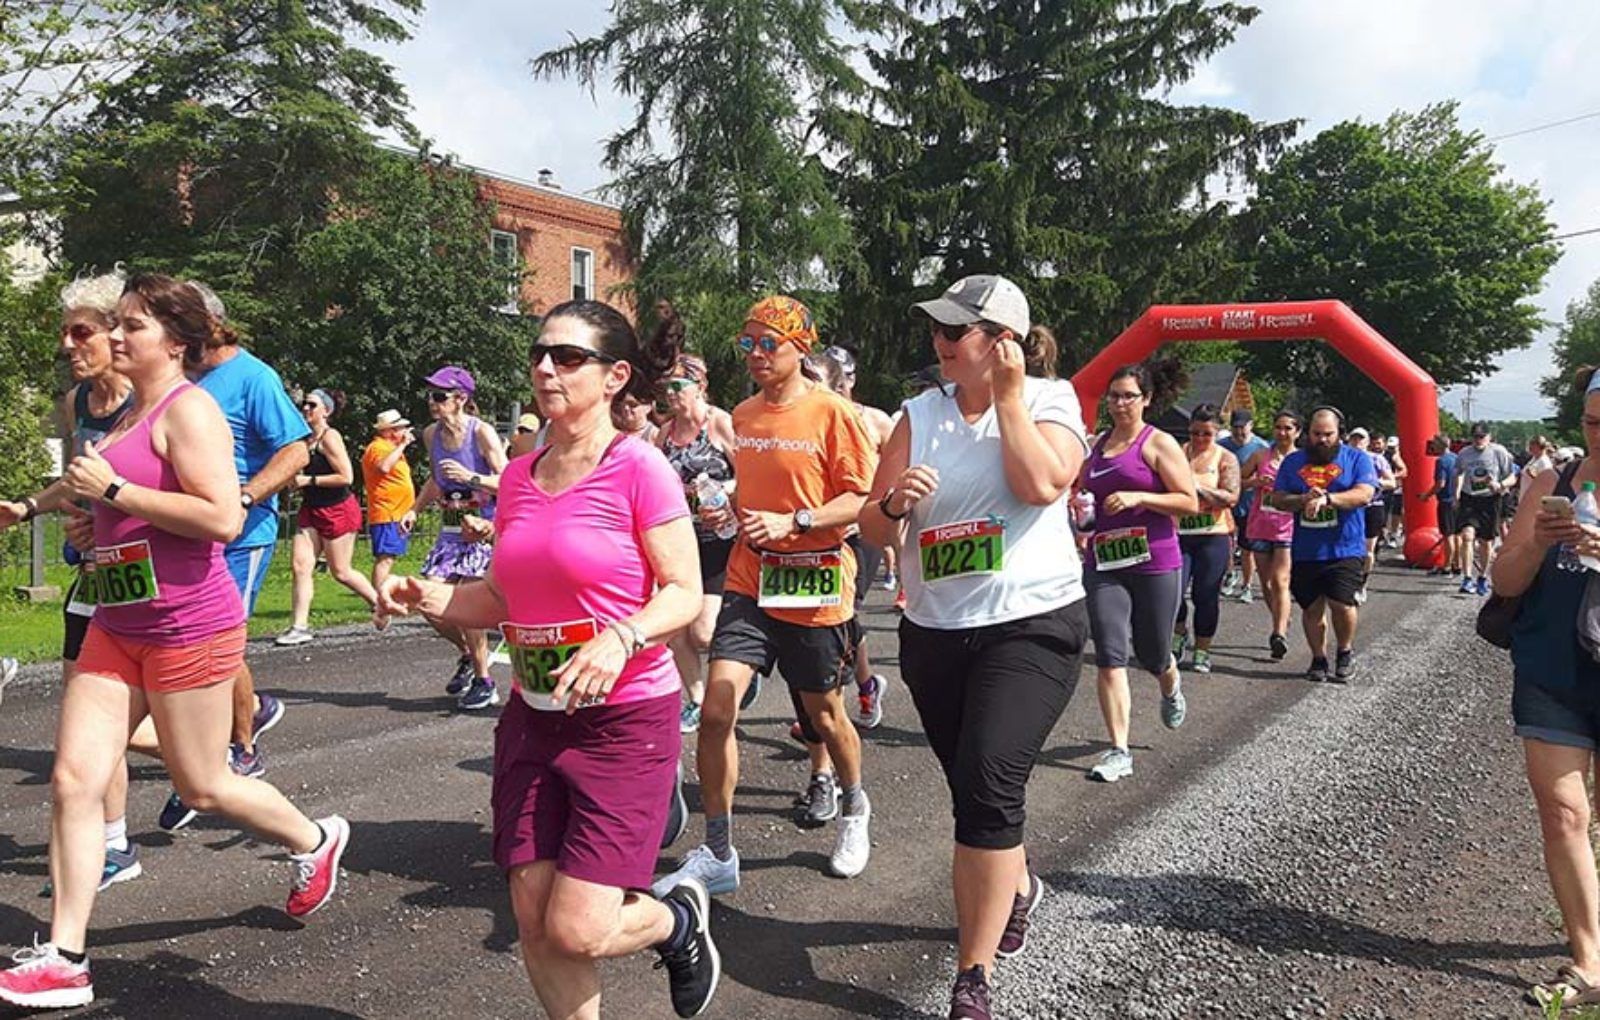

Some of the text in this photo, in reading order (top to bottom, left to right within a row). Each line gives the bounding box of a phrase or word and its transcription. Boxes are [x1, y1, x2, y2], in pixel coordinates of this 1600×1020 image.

[1222, 309, 1256, 320] START
[926, 537, 993, 578] 4221
[1097, 537, 1143, 564] 4104
[764, 568, 834, 595] 4048
